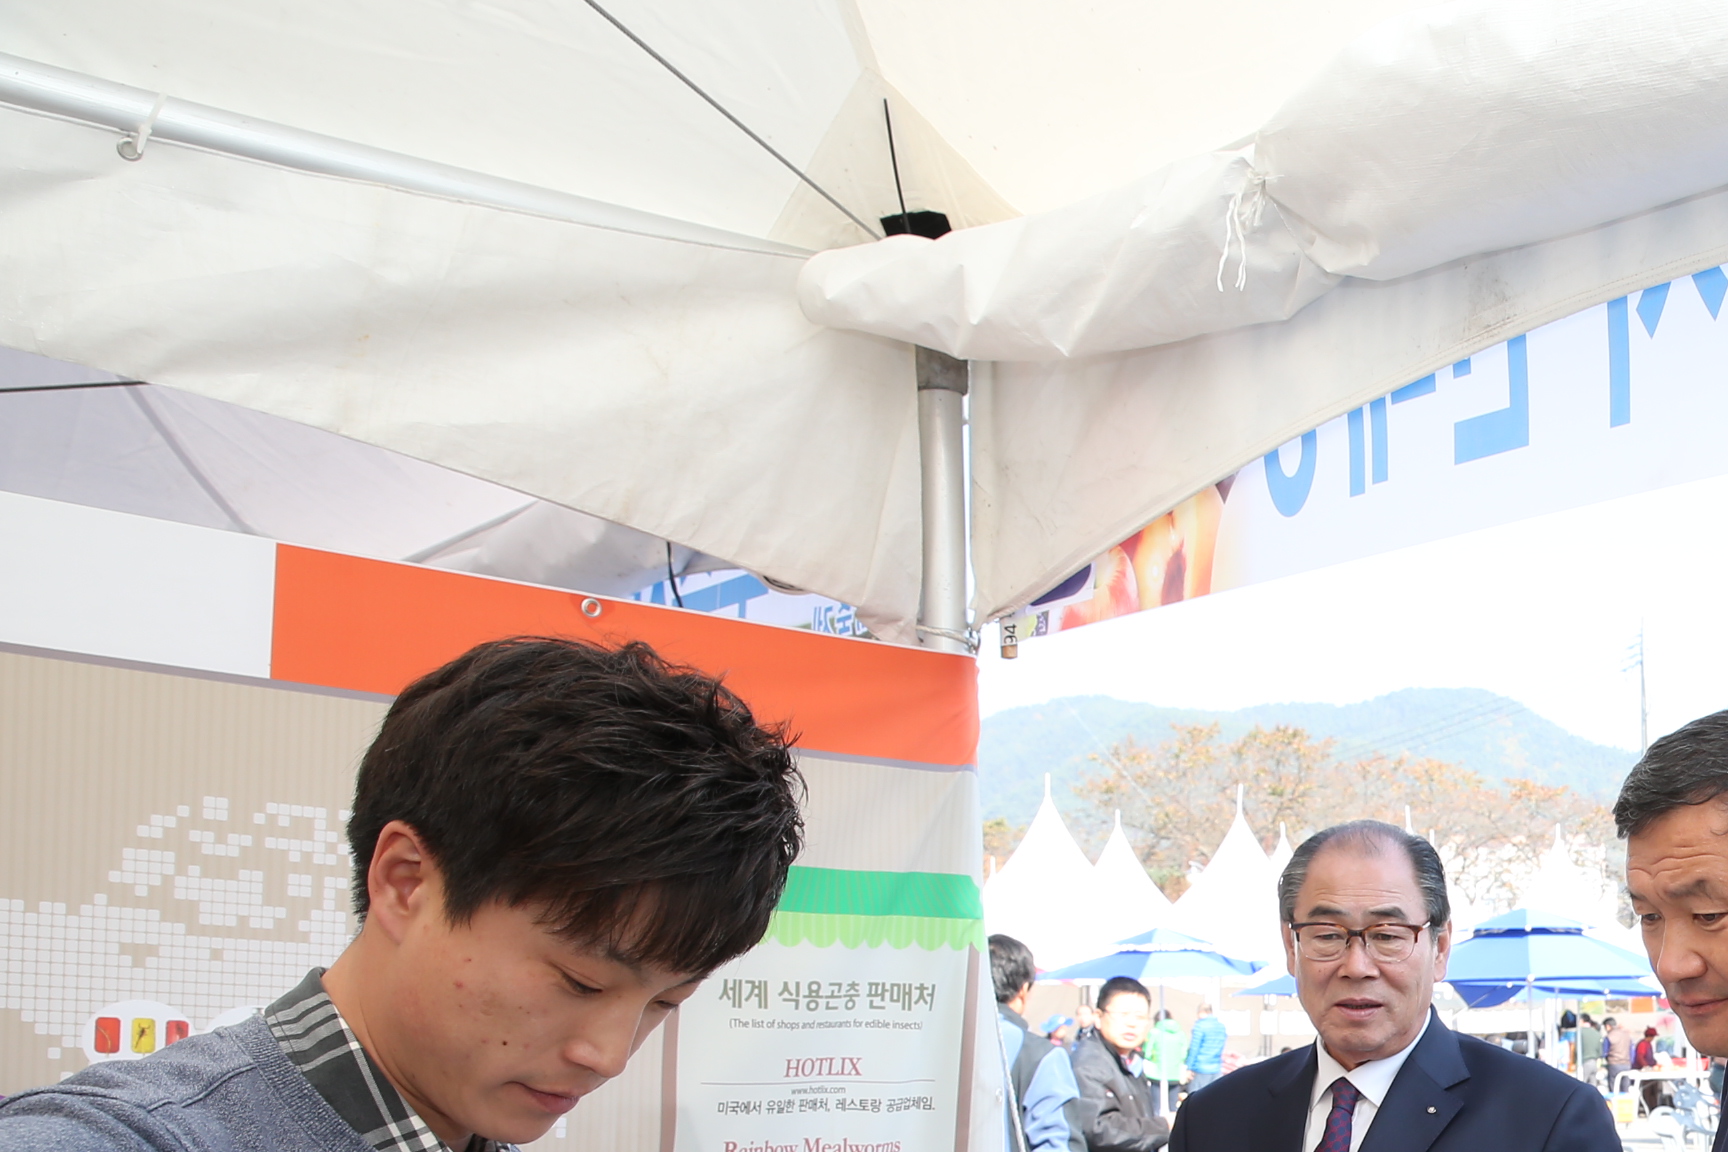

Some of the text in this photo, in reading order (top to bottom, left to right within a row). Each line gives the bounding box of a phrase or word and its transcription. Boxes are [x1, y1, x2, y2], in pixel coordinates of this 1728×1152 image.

[719, 979, 936, 1012] 세계 식용곤충 판매처
[729, 1018, 923, 1031] (The list of shops and restaurants for edible insects)
[784, 1057, 862, 1077] HOTLIX
[791, 1085, 846, 1095] www.hotlix.com
[717, 1099, 762, 1115] 미국에서
[765, 1099, 795, 1114] 유일한
[798, 1098, 831, 1113] 판매처,
[835, 1097, 882, 1113] 레스토랑
